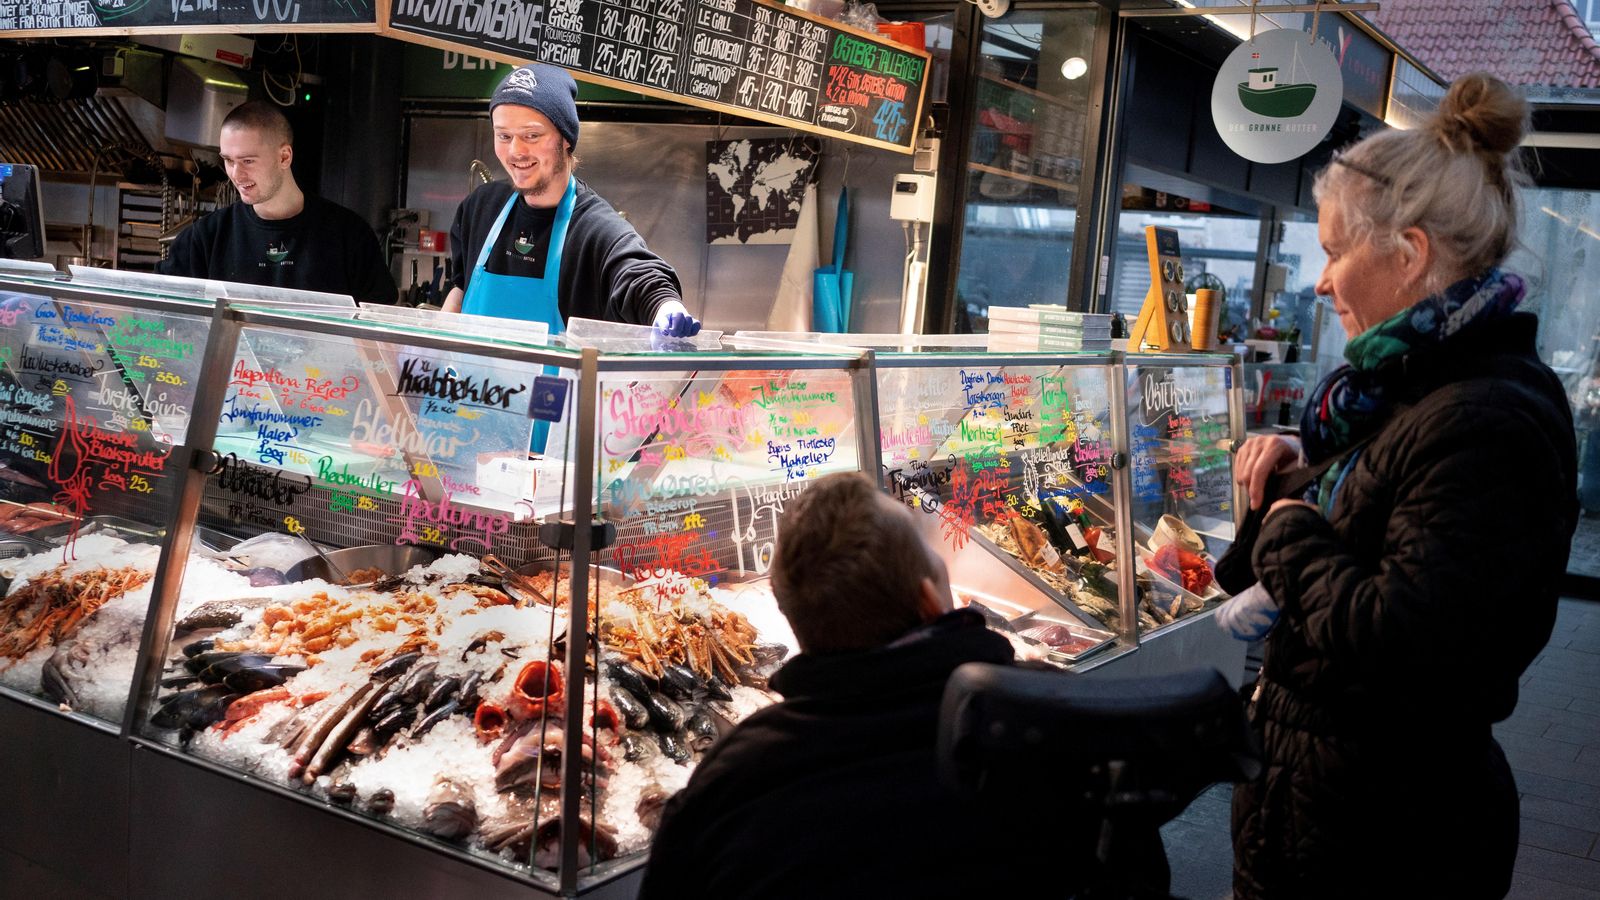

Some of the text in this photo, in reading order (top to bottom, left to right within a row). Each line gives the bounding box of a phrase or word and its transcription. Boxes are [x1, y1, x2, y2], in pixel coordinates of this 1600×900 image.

[20, 15, 35, 29] FRA
[697, 8, 711, 27] LE
[711, 12, 732, 32] GALL
[755, 6, 772, 23] STK
[776, 13, 784, 27] 6
[784, 16, 798, 33] STK
[800, 20, 813, 37] 12
[812, 27, 828, 43] STK
[1248, 123, 1281, 132] GRØNNE
